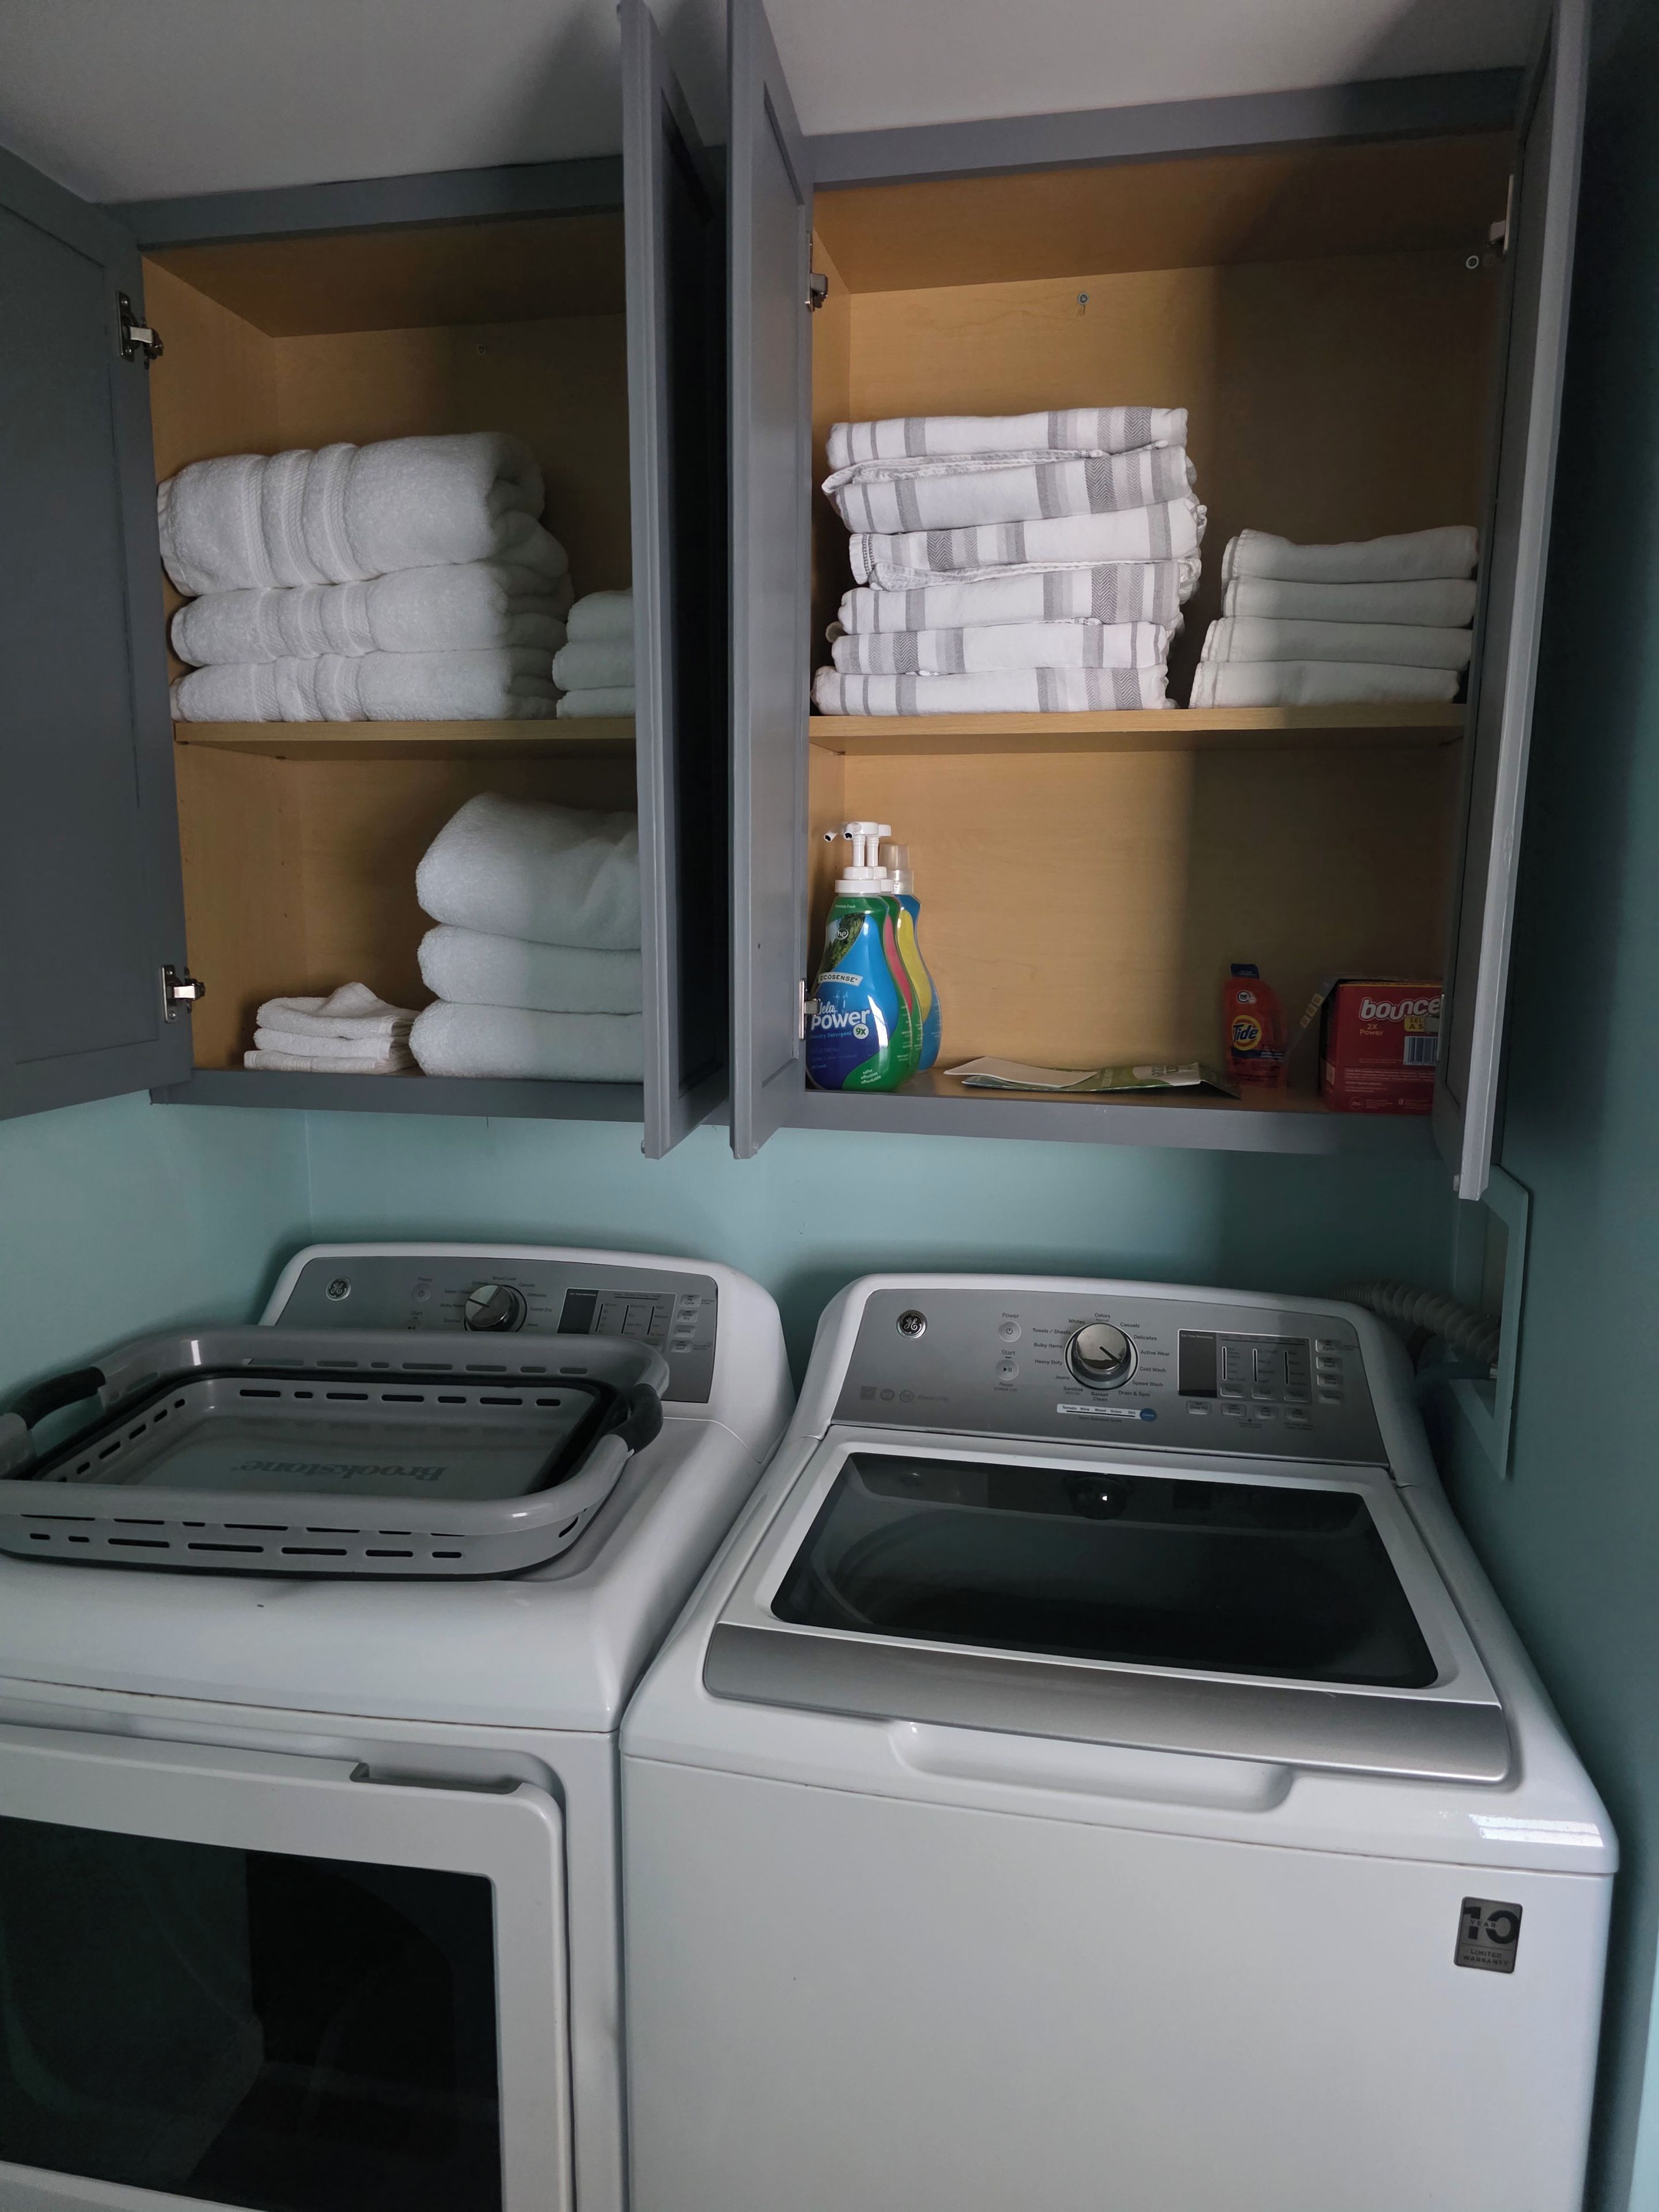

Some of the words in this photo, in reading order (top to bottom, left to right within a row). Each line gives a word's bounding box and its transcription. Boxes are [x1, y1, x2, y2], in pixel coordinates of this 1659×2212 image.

[1359, 997, 1441, 1021] bounce
[811, 1009, 870, 1031] Power
[1233, 1023, 1259, 1043] Tide
[240, 1461, 449, 1481] Brookstone
[1464, 1907, 1520, 1944] 10
[1469, 1919, 1497, 1928] YEAR
[1463, 1955, 1508, 1966] WARRANTY
[1470, 1949, 1502, 1959] LIMITED
